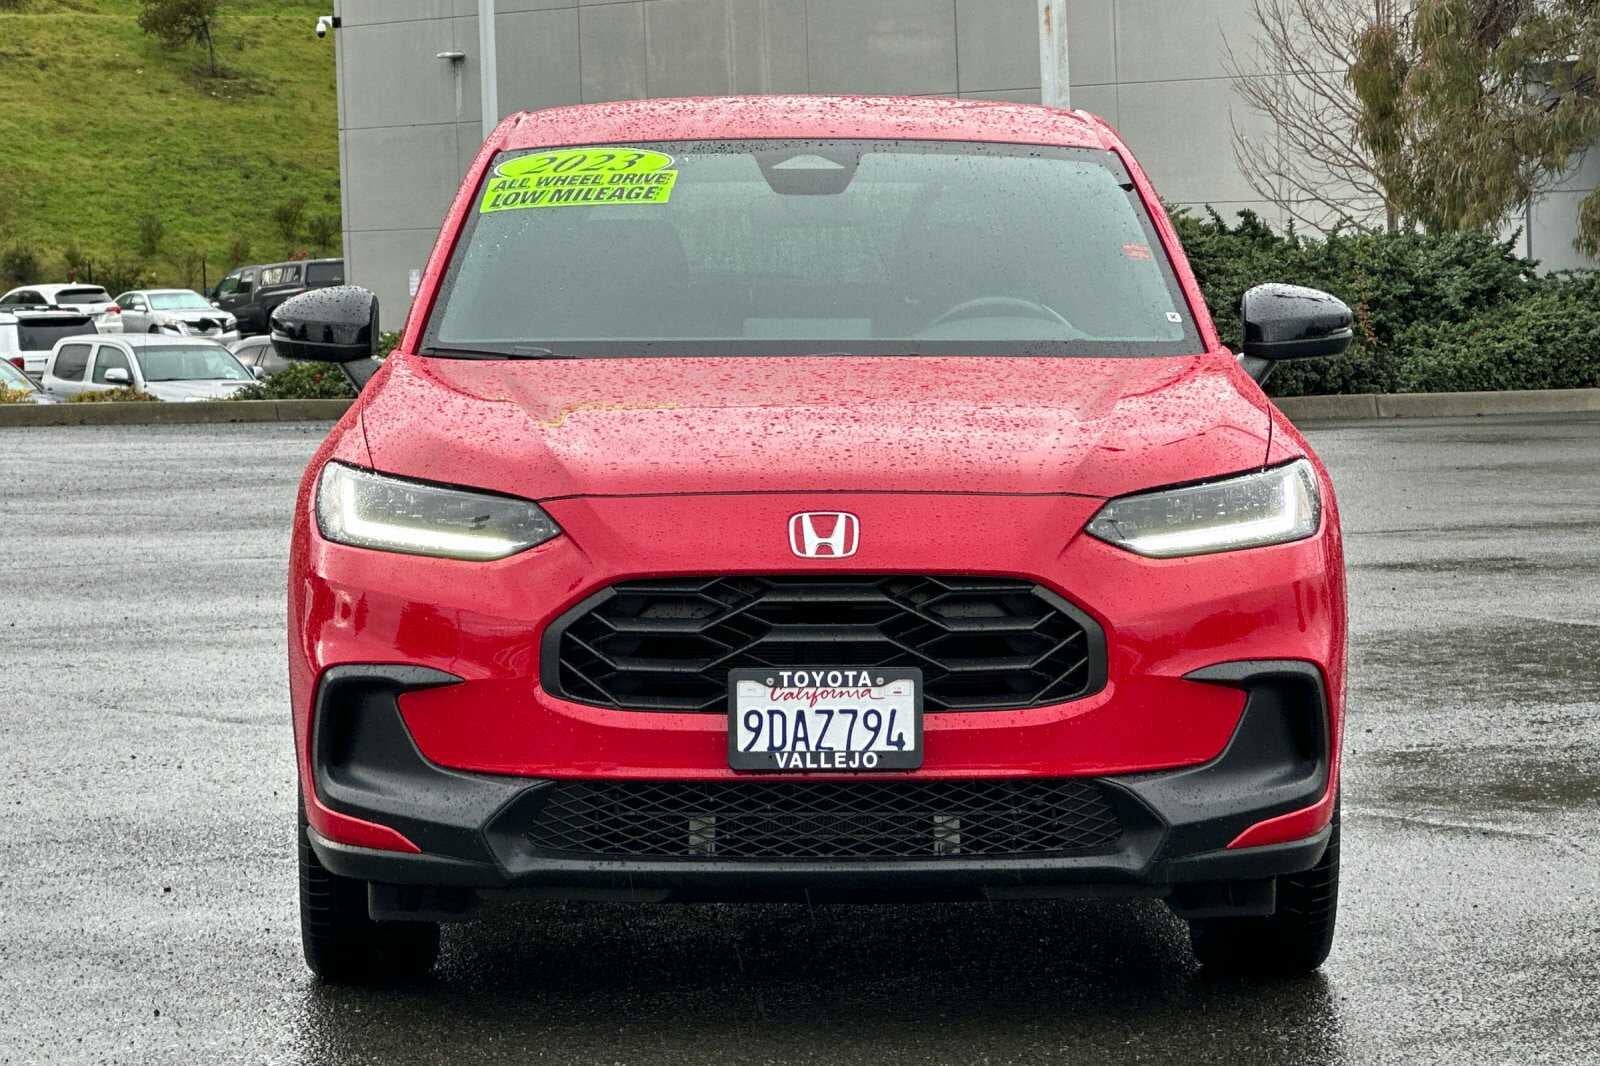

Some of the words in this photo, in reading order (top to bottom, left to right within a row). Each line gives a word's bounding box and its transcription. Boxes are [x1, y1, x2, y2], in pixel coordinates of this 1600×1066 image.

[520, 152, 644, 175] 2023
[493, 177, 528, 191] ALL
[538, 174, 600, 188] WHEEL
[608, 171, 670, 185] DRIVE
[489, 189, 545, 208] LOW
[549, 185, 661, 203] MILEAGE
[779, 671, 872, 687] TOYOTA
[770, 686, 885, 708] California
[743, 708, 906, 751] 9DAZ794
[775, 752, 878, 768] VALLEJO
